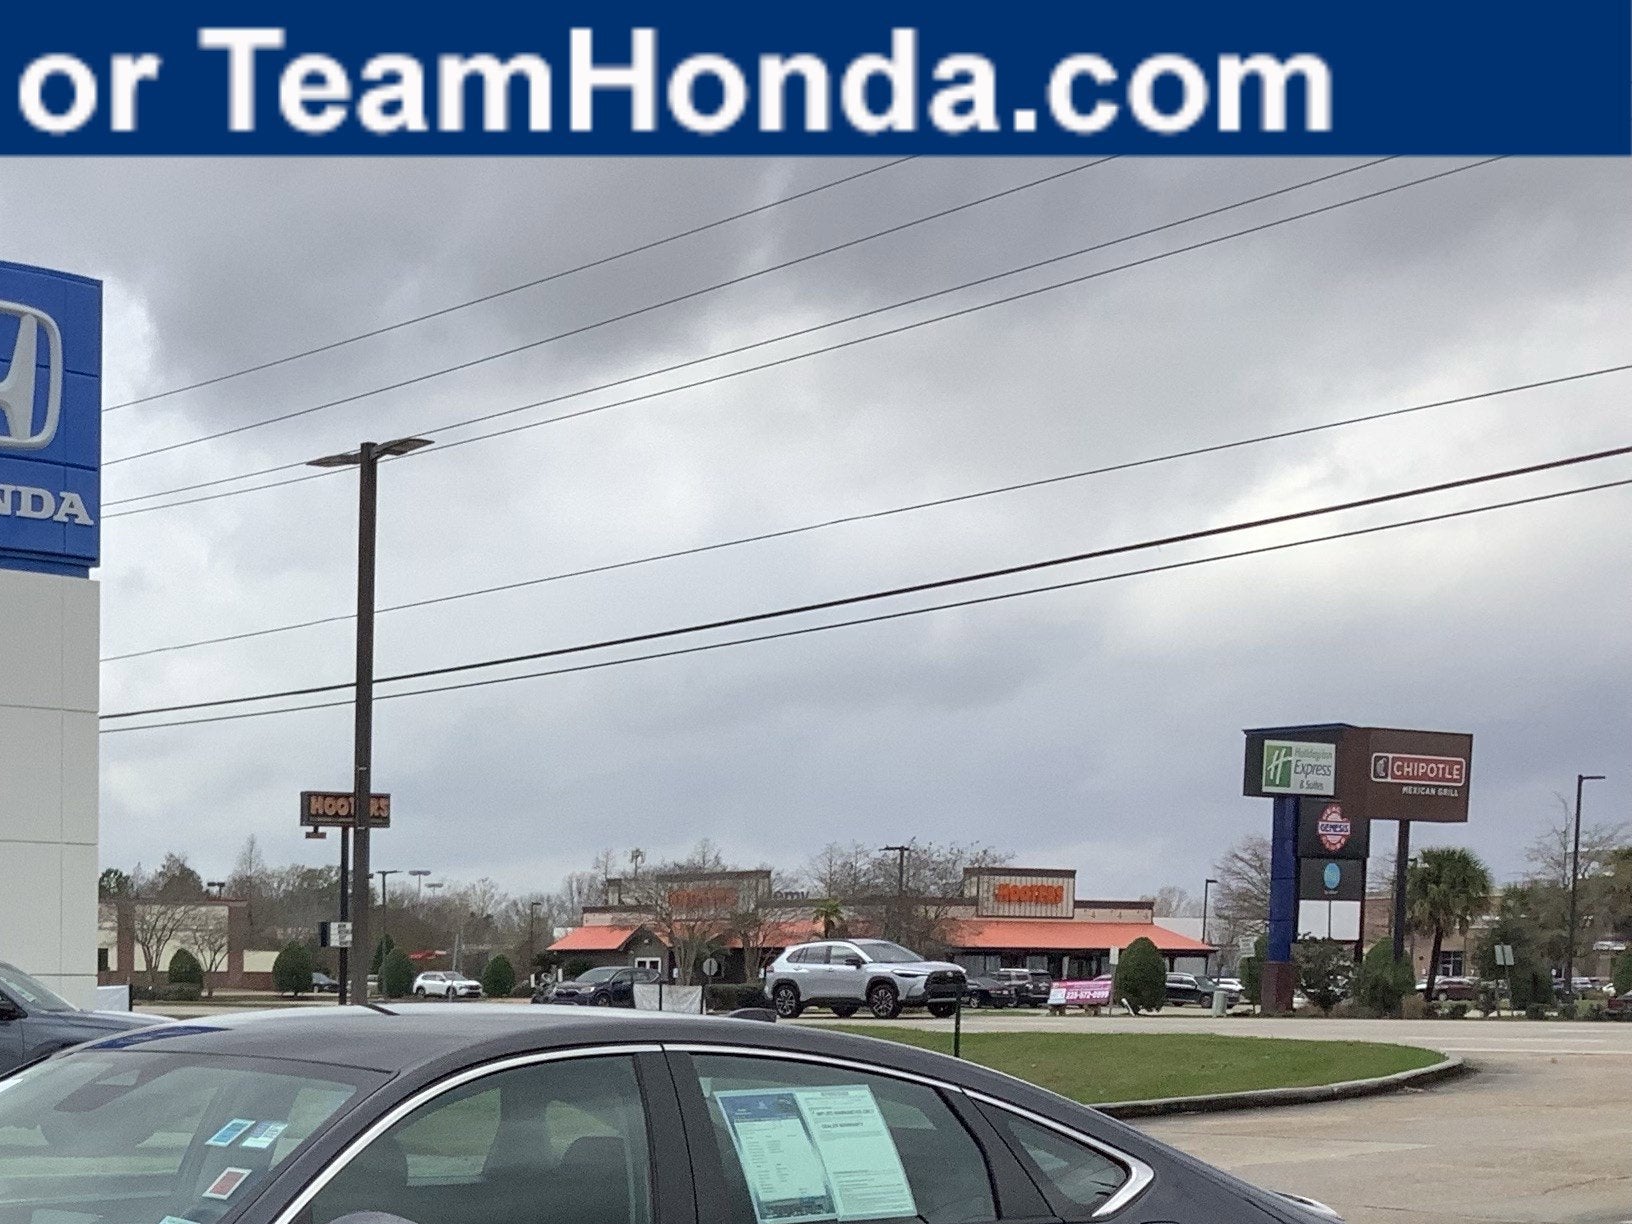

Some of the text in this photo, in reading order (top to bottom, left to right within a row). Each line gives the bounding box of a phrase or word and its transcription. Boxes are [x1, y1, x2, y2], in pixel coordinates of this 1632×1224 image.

[1294, 759, 1332, 778] Express
[1393, 761, 1461, 779] CHIPOTLE
[1401, 786, 1458, 797] MEXICAN GRILL
[310, 796, 389, 817] HOORS
